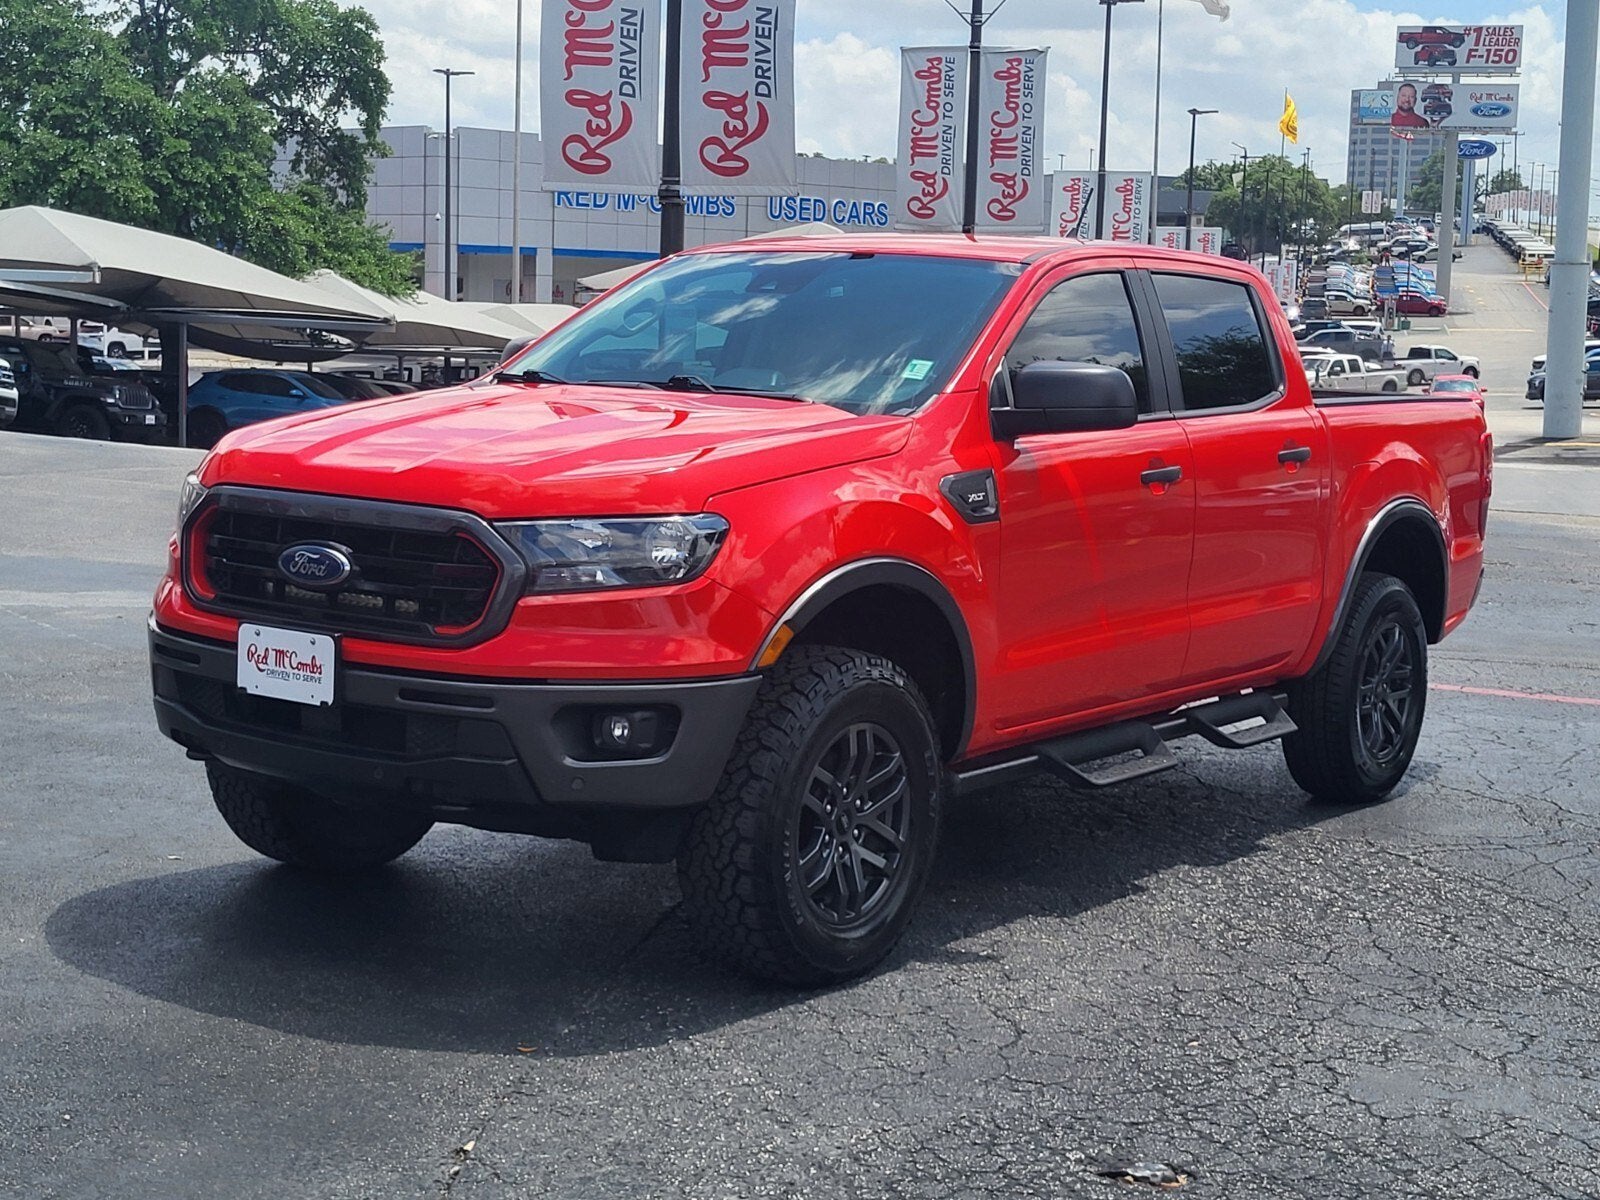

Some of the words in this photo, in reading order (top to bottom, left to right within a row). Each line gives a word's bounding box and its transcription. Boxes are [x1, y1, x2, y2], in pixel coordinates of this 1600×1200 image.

[1463, 26, 1484, 47] #1
[1482, 37, 1520, 47] LEADER
[1484, 26, 1515, 37] SALES
[619, 7, 638, 99] DRIVEN
[755, 6, 773, 99] DRIVEN
[1465, 48, 1518, 65] F-150
[944, 55, 956, 98] SERVE
[1023, 57, 1035, 98] SERVE
[909, 56, 943, 166] McCombs
[943, 101, 953, 120] TO
[989, 57, 1023, 168] McCombs
[1022, 102, 1033, 121] TO
[1477, 104, 1504, 116] Ford
[561, 88, 633, 175] Red
[699, 90, 769, 177] Red
[941, 125, 953, 176] DRIVEN
[1020, 125, 1032, 177] DRIVEN
[1458, 142, 1487, 156] Ford
[906, 170, 949, 219] Red
[986, 172, 1029, 222] Red
[1134, 177, 1143, 206] SERVE
[556, 191, 609, 208] RED
[769, 196, 827, 222] USED
[833, 199, 889, 227] CARS
[1133, 208, 1141, 220] TO
[967, 492, 986, 503] XLT
[290, 550, 330, 577] Ford
[247, 643, 269, 672] Red
[271, 648, 323, 676] McCombs
[266, 668, 290, 679] DRIVEN
[292, 672, 301, 681] TO
[302, 674, 323, 684] SERVE
